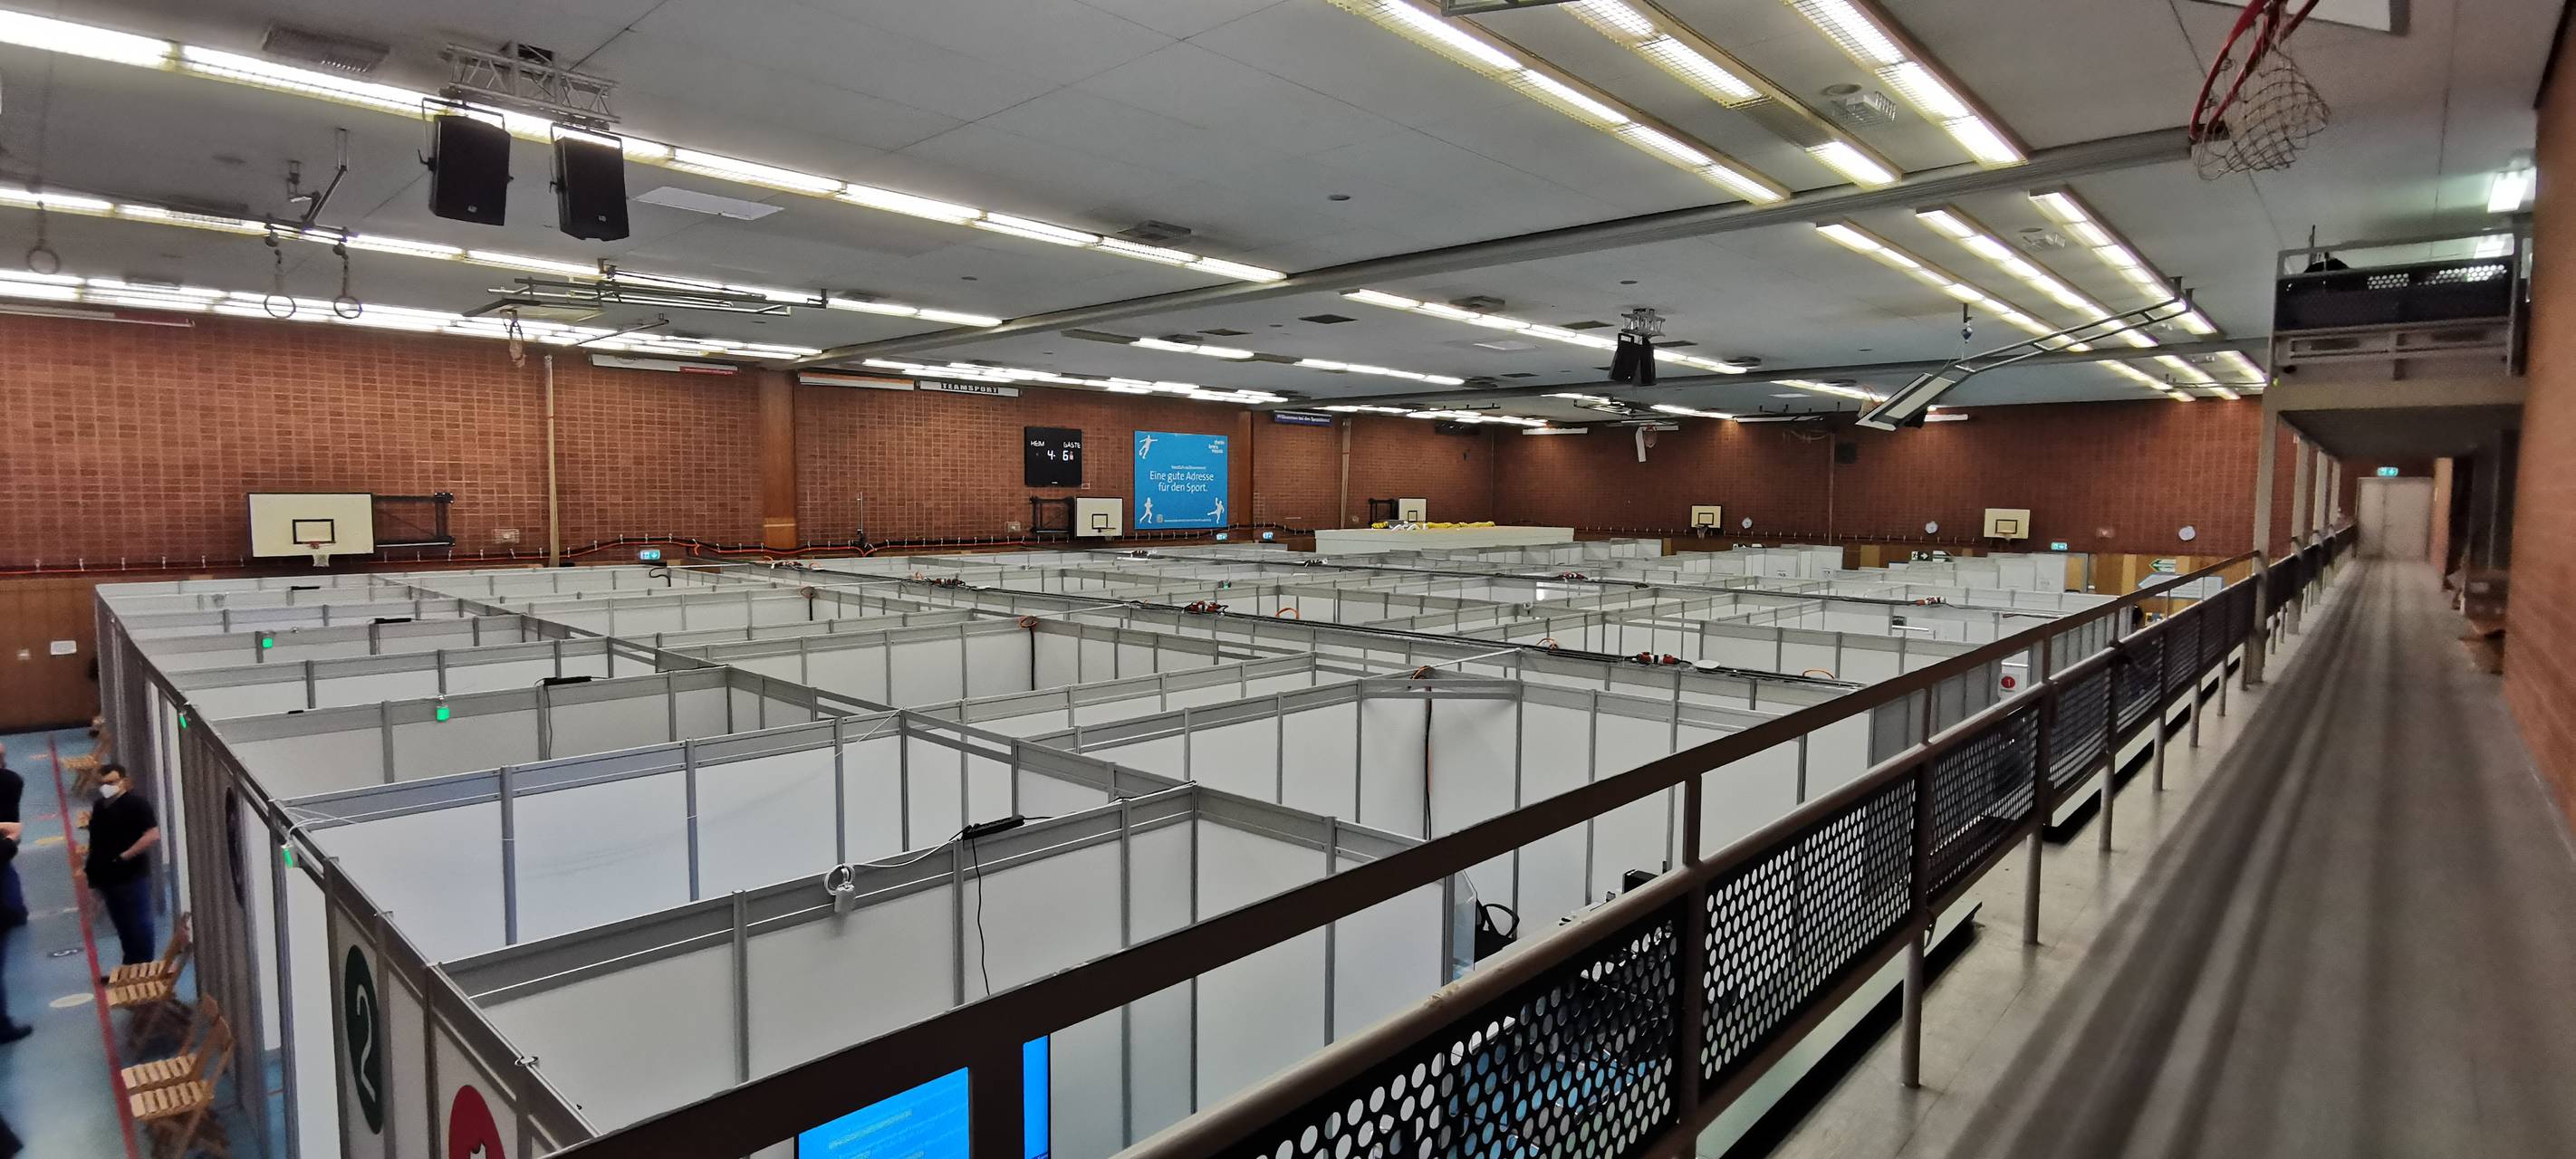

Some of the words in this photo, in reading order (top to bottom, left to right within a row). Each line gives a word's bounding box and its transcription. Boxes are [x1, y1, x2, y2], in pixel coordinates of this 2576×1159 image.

[941, 382, 998, 394] TEAMSPORT
[1149, 470, 1167, 481] Eine
[1168, 471, 1185, 483] gute
[1185, 471, 1215, 481] Adresse
[1158, 482, 1170, 492] für
[1171, 482, 1186, 492] den
[1187, 482, 1209, 494] Sport.
[356, 983, 377, 1103] 2
